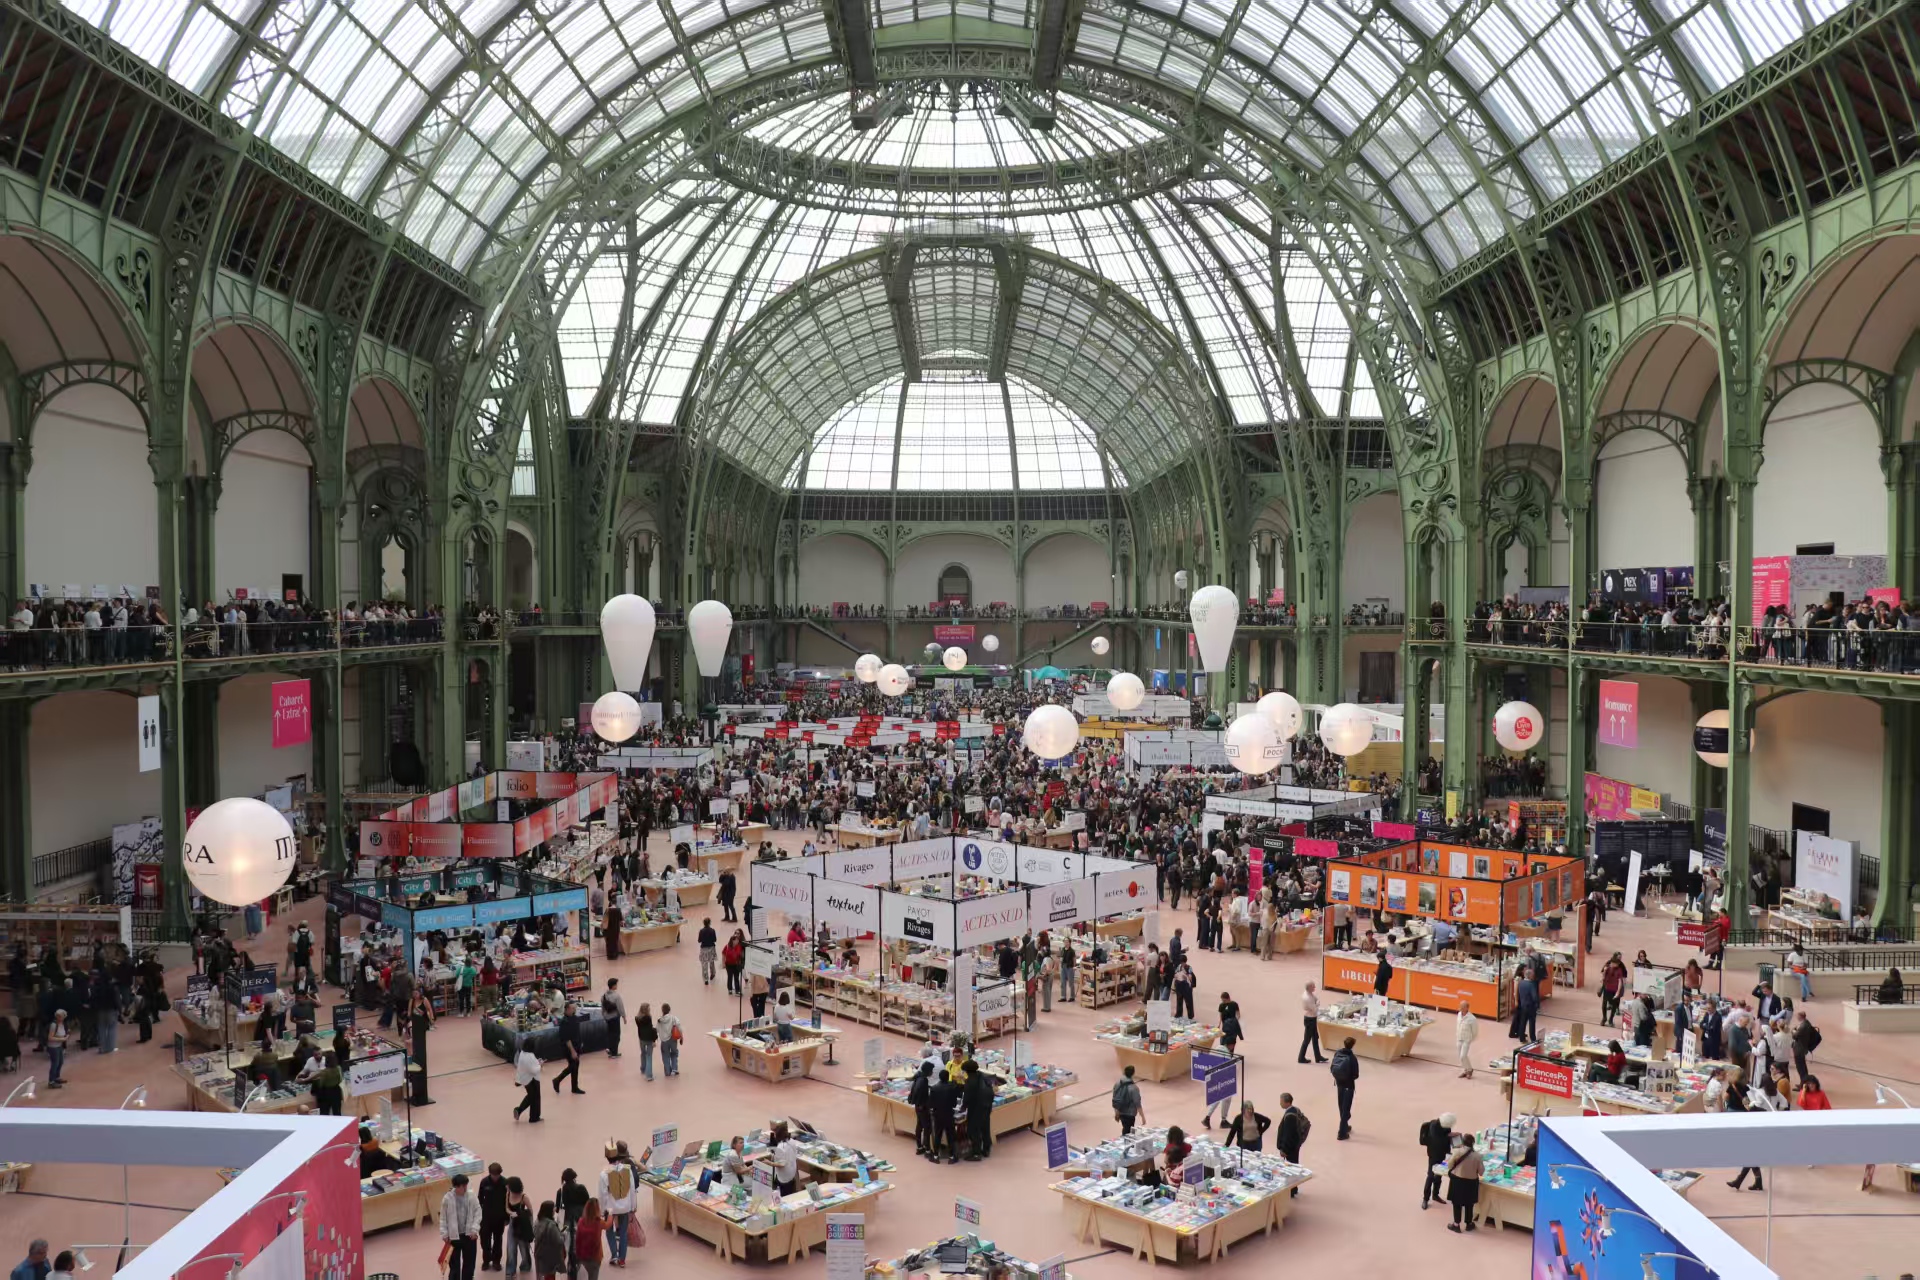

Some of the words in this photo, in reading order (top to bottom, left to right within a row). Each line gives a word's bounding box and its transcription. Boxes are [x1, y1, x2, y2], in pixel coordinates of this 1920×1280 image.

[1605, 698, 1633, 713] Romance
[506, 778, 529, 793] folio
[896, 851, 928, 866] ACTES
[931, 849, 950, 861] SUD
[843, 862, 874, 874] Rivages
[759, 880, 787, 897] ACTES
[789, 887, 808, 902] SUD
[1104, 888, 1123, 898] actes
[826, 895, 865, 916] textuel
[907, 905, 931, 918] PAYOT
[961, 911, 998, 934] ACTES
[1000, 907, 1023, 923] SUD
[907, 921, 931, 936] Rivages
[362, 1067, 399, 1080] radiofrance
[1525, 1064, 1568, 1081] SciencesPo
[828, 1224, 864, 1232] Sciences
[828, 1231, 845, 1239] pour
[846, 1231, 864, 1239] tous
